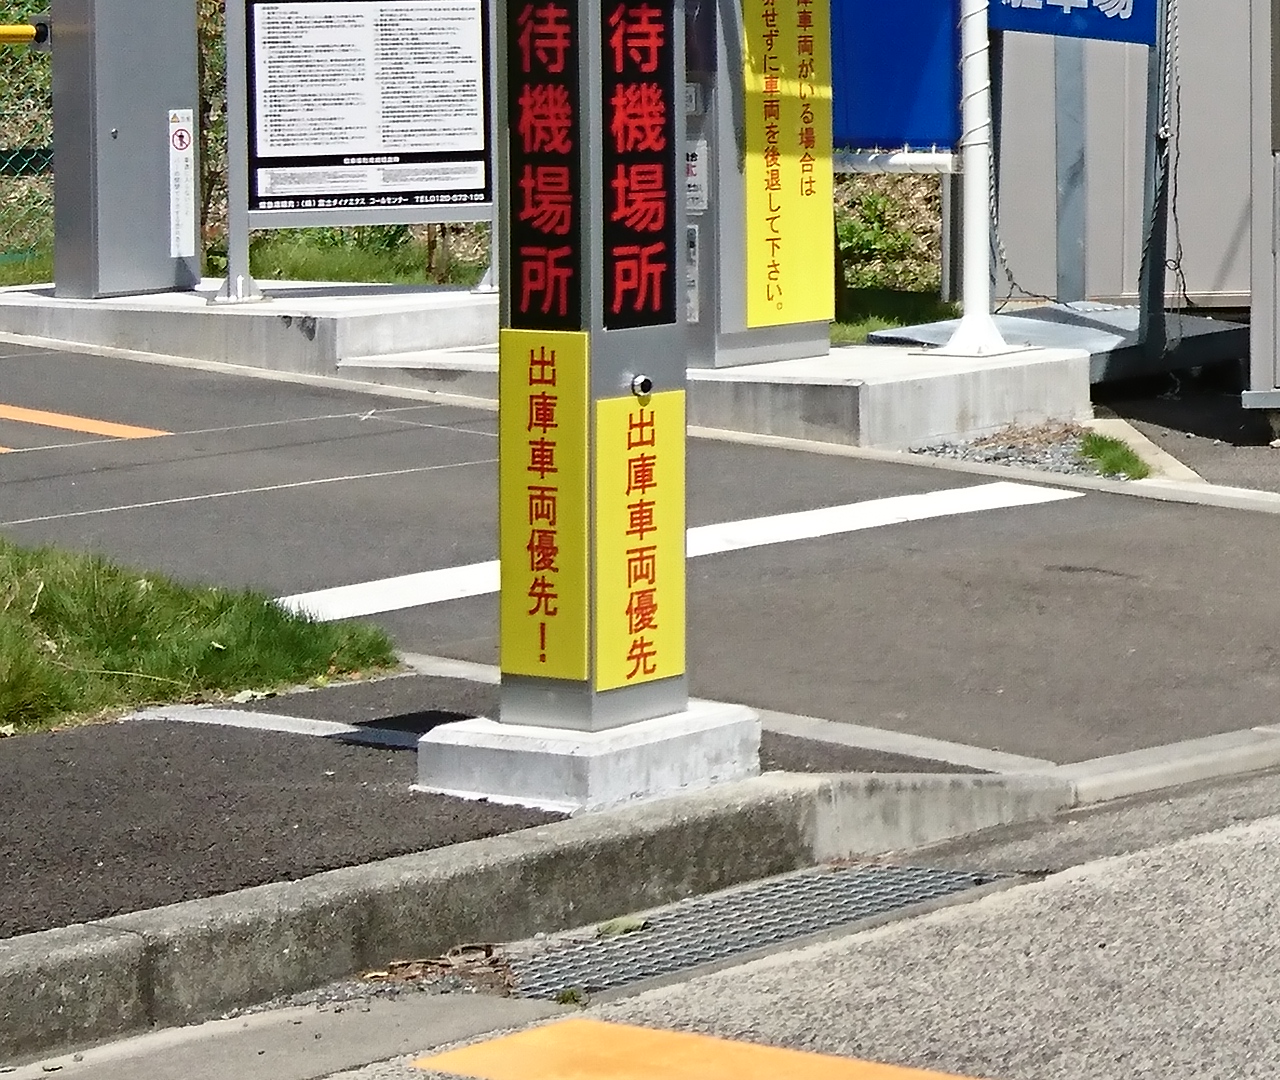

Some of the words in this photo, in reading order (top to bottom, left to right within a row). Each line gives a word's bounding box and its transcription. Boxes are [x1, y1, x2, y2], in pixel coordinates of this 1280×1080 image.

[516, 2, 573, 317] 待機場所
[609, 2, 668, 315] 待機場所
[526, 346, 559, 663] 出庫車両優先！
[625, 408, 658, 680] 出庫車両優先
